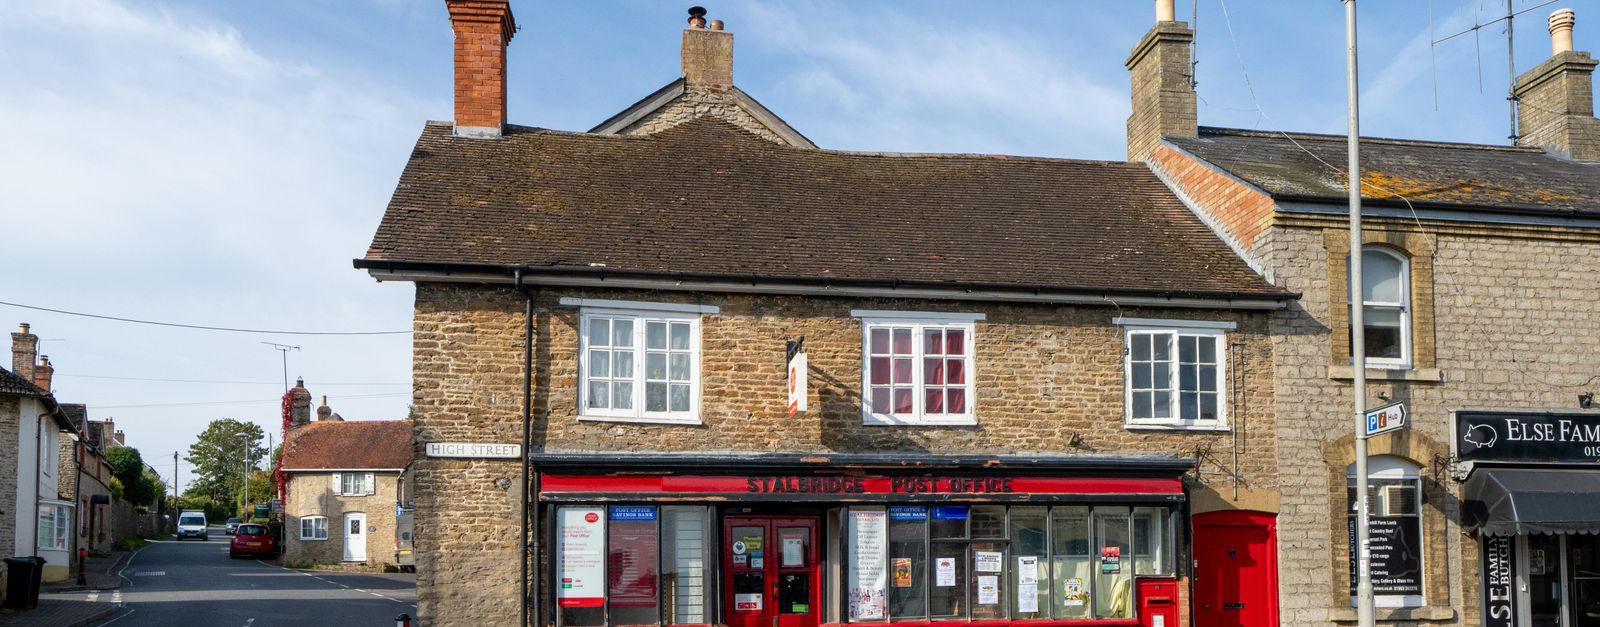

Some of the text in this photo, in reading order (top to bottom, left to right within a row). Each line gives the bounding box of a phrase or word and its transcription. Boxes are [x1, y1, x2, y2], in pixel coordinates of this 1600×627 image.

[1388, 413, 1398, 421] Hub
[431, 444, 517, 456] HIGH STREET
[746, 477, 1013, 494] STALBRIDGE POST OFFICE
[1489, 536, 1499, 585] FAMILY
